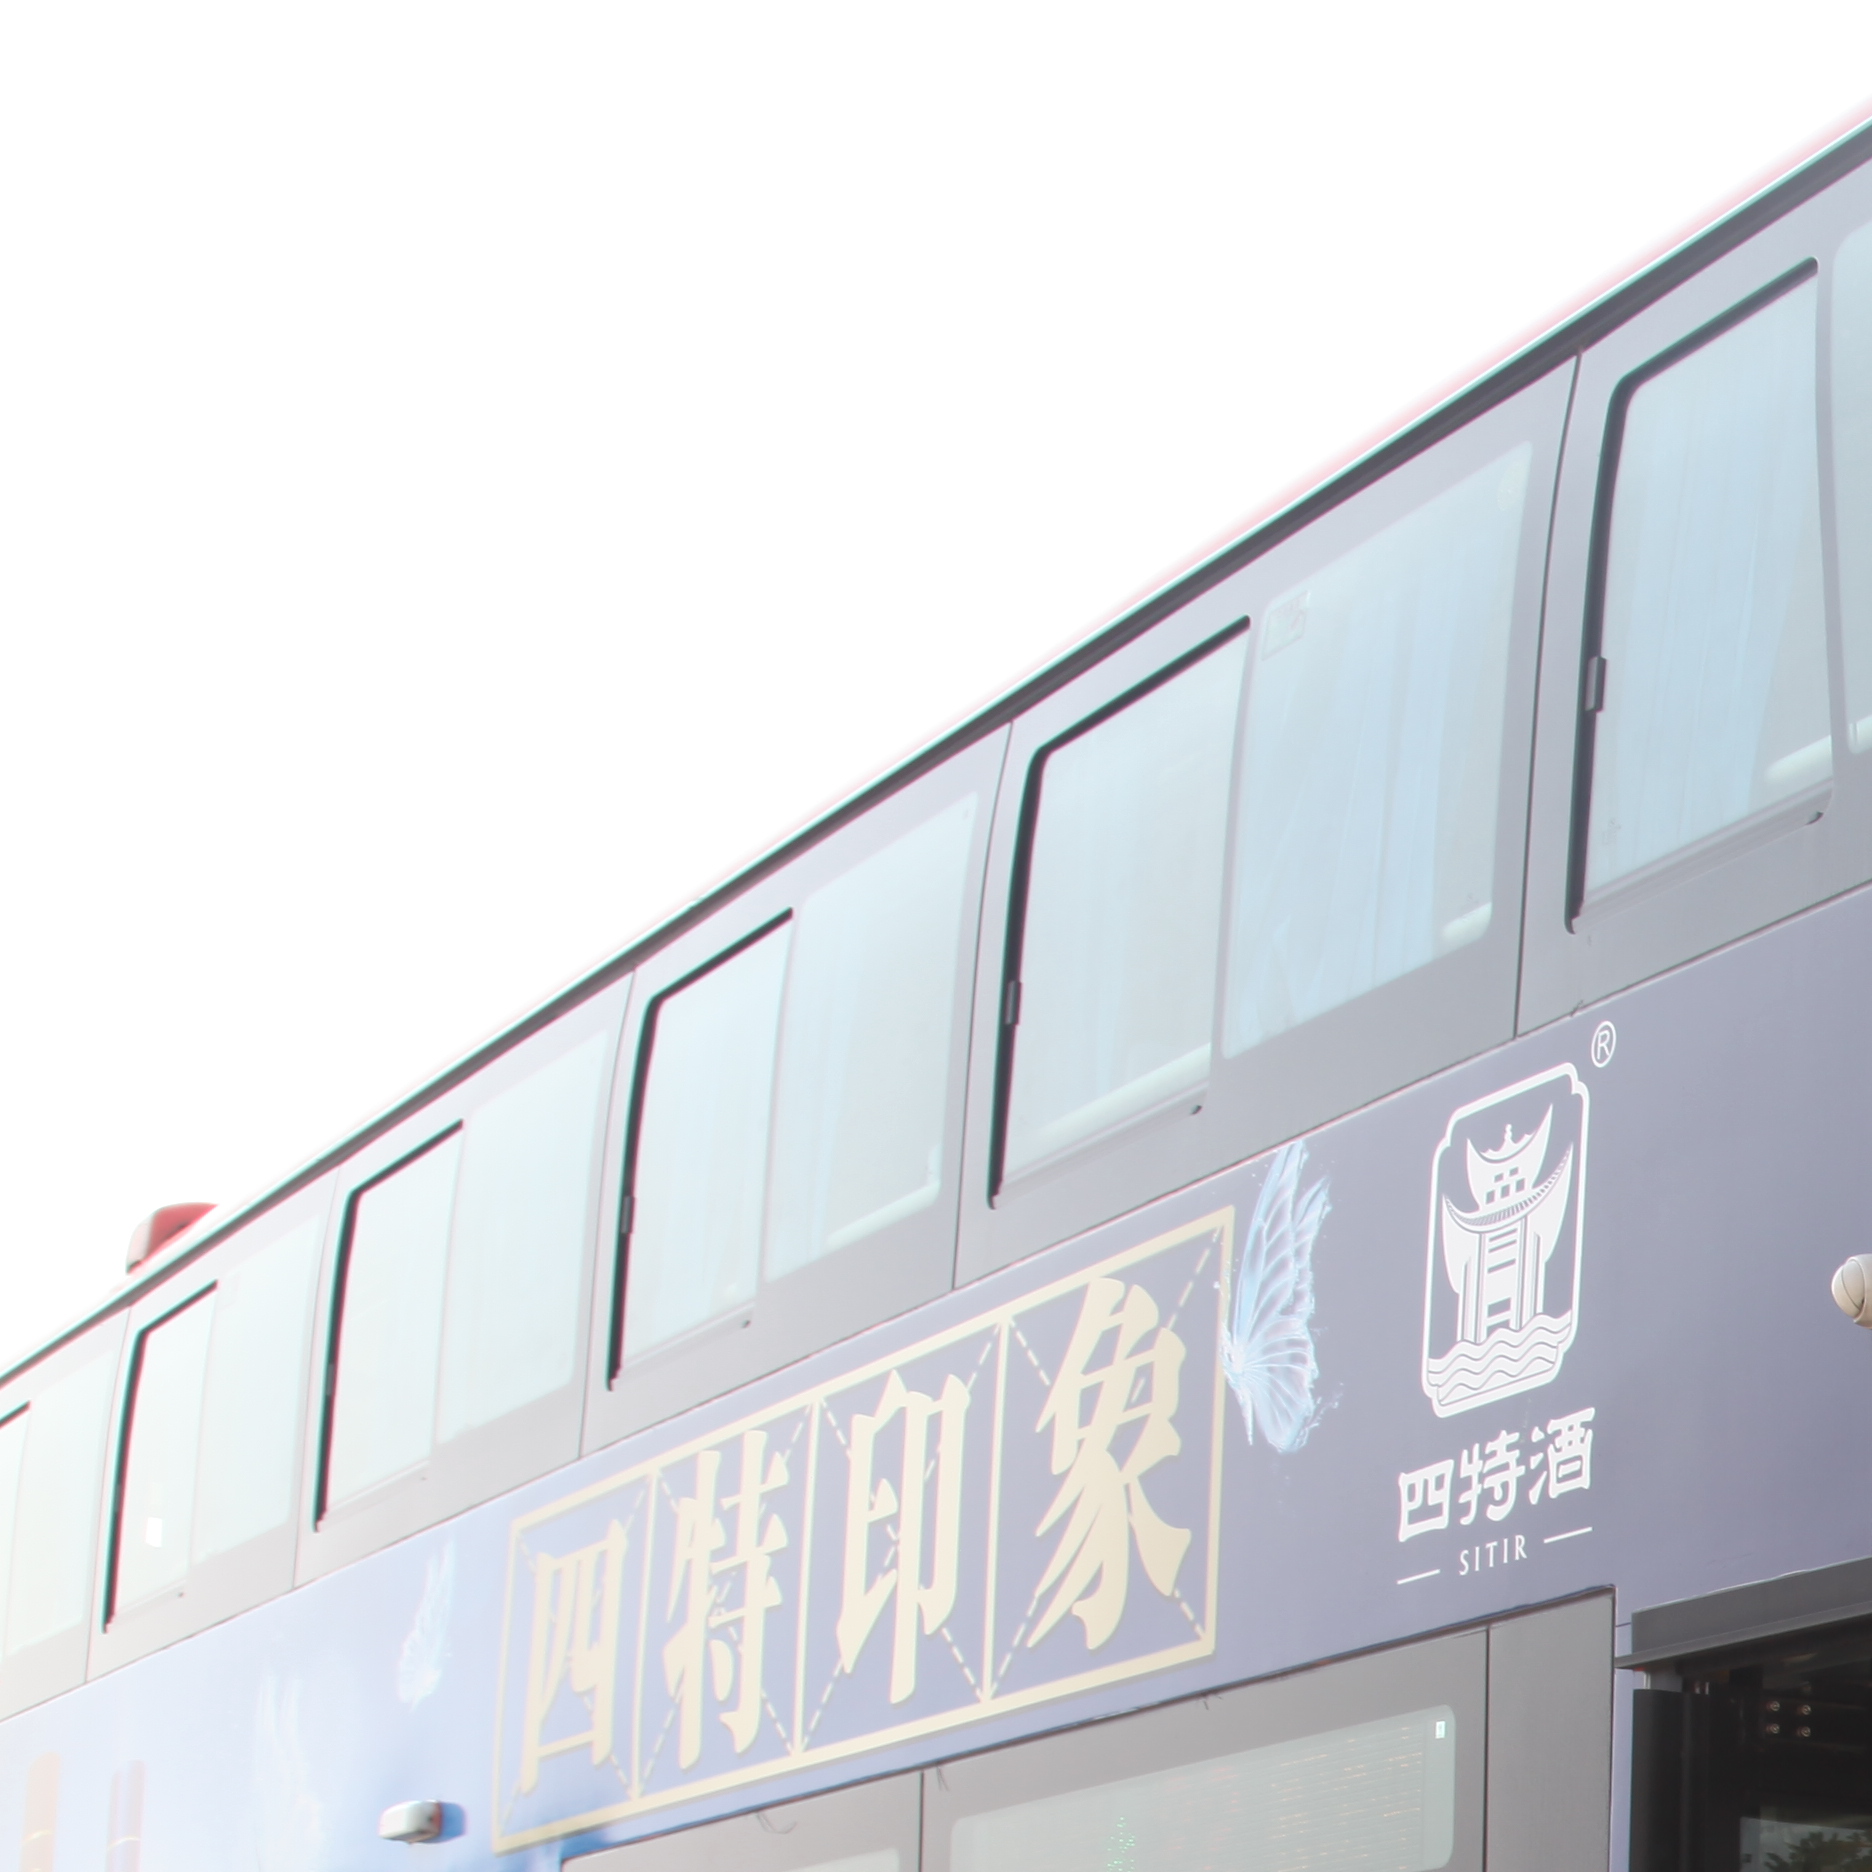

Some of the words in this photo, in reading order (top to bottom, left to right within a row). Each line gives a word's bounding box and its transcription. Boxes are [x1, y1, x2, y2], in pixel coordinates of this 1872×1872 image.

[518, 1277, 1193, 1796] 四特印象
[1397, 1406, 1597, 1544] 四特酒
[1457, 1535, 1529, 1577] SITIR
